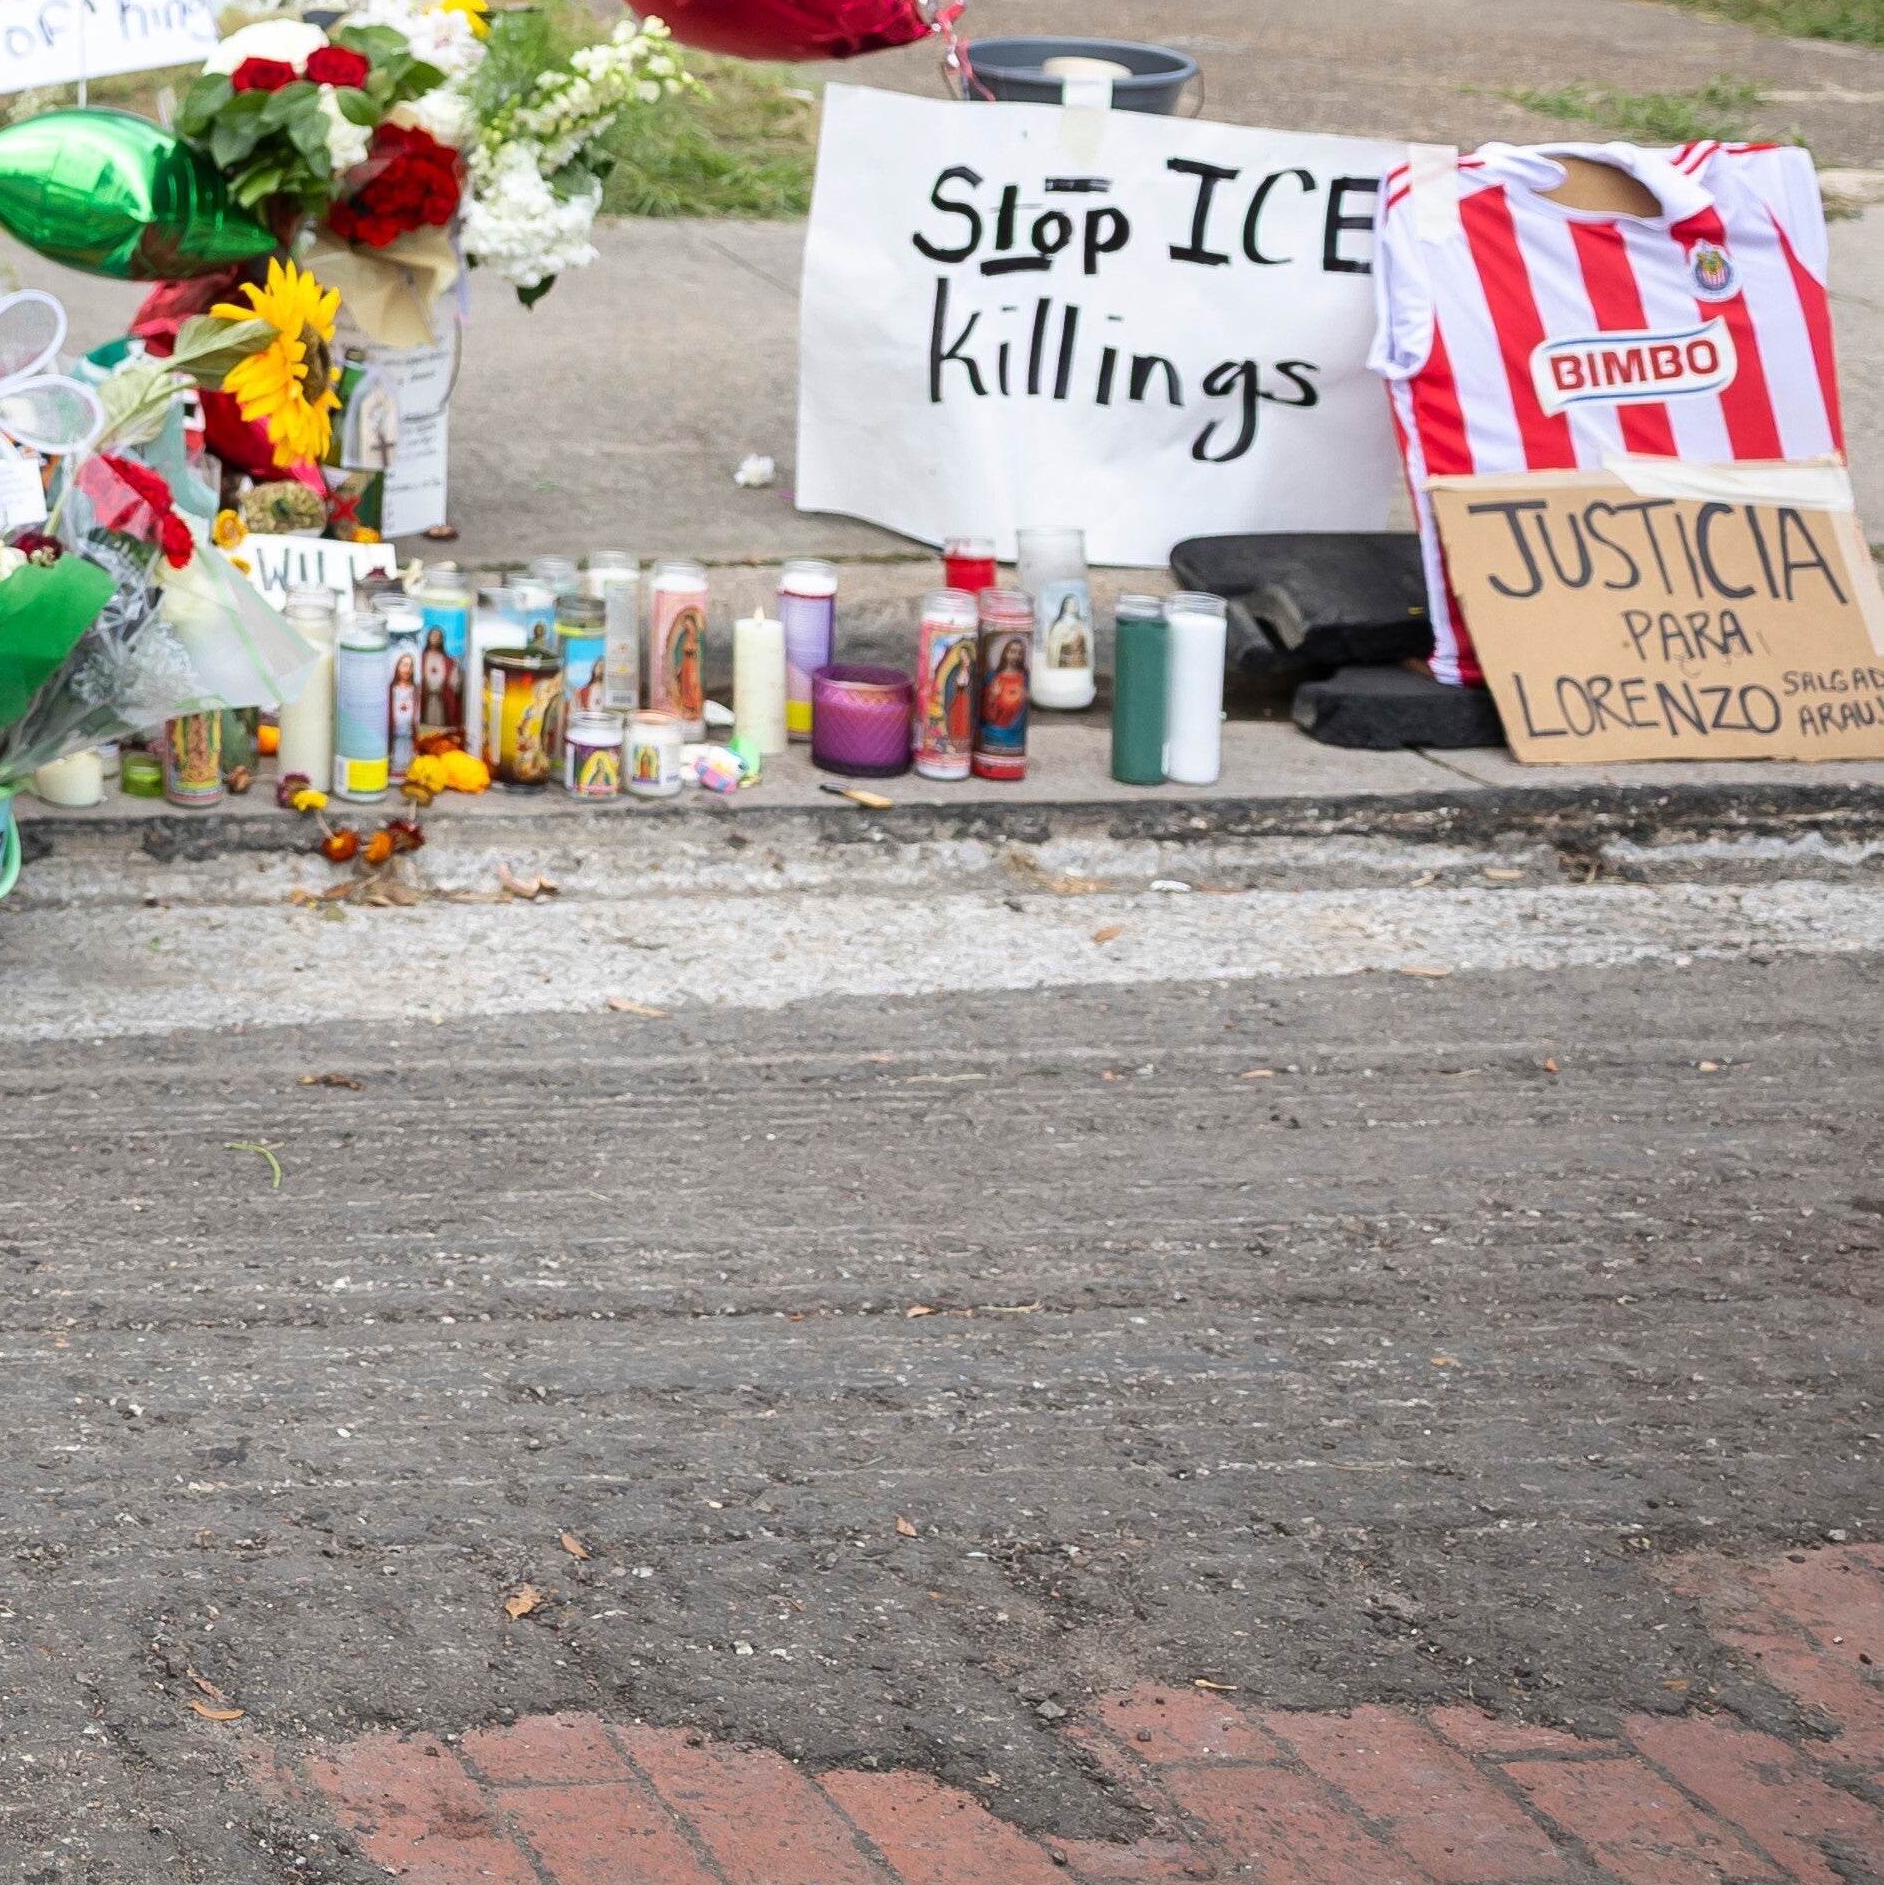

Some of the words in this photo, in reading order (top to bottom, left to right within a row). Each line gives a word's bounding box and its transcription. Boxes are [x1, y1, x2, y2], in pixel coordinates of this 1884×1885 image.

[913, 165, 1131, 276] Stop
[1167, 157, 1379, 273] ICE
[1550, 339, 1719, 391] BIMBO
[1468, 498, 1849, 605] JUSTICIA
[1622, 610, 1753, 662] PARA
[1513, 673, 1782, 738] LORENZO
